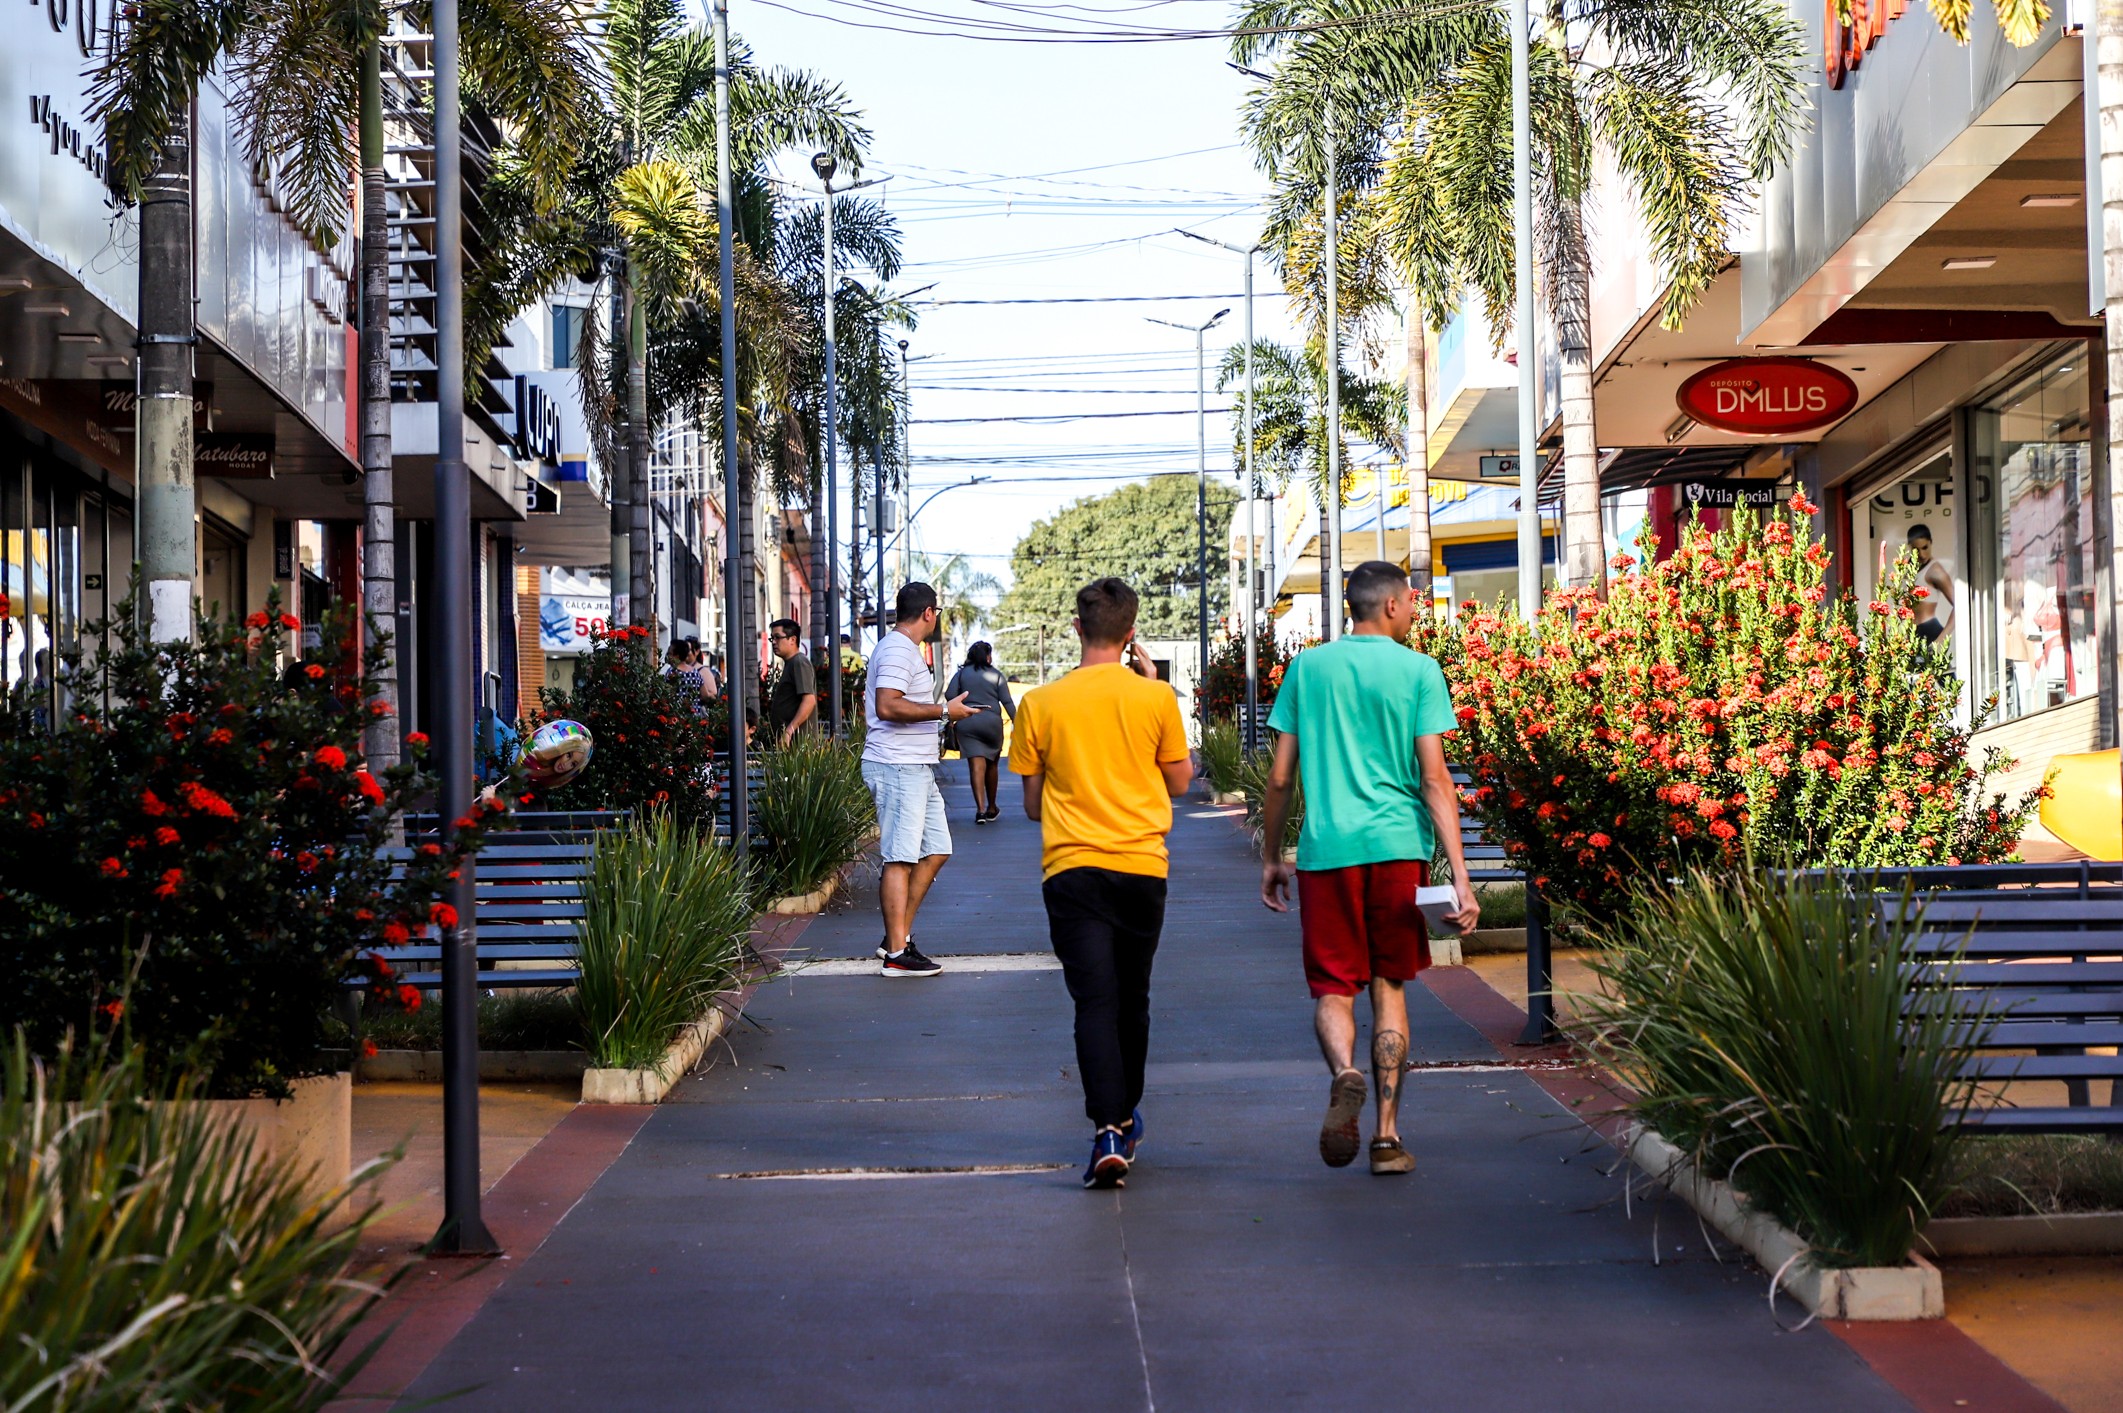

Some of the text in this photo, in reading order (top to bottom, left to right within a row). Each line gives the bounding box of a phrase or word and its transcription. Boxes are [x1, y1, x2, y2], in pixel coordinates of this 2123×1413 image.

[515, 375, 562, 468] LUPO
[1705, 489, 1733, 503] Vila
[565, 600, 592, 611] CALÇA
[575, 617, 605, 637] 59
